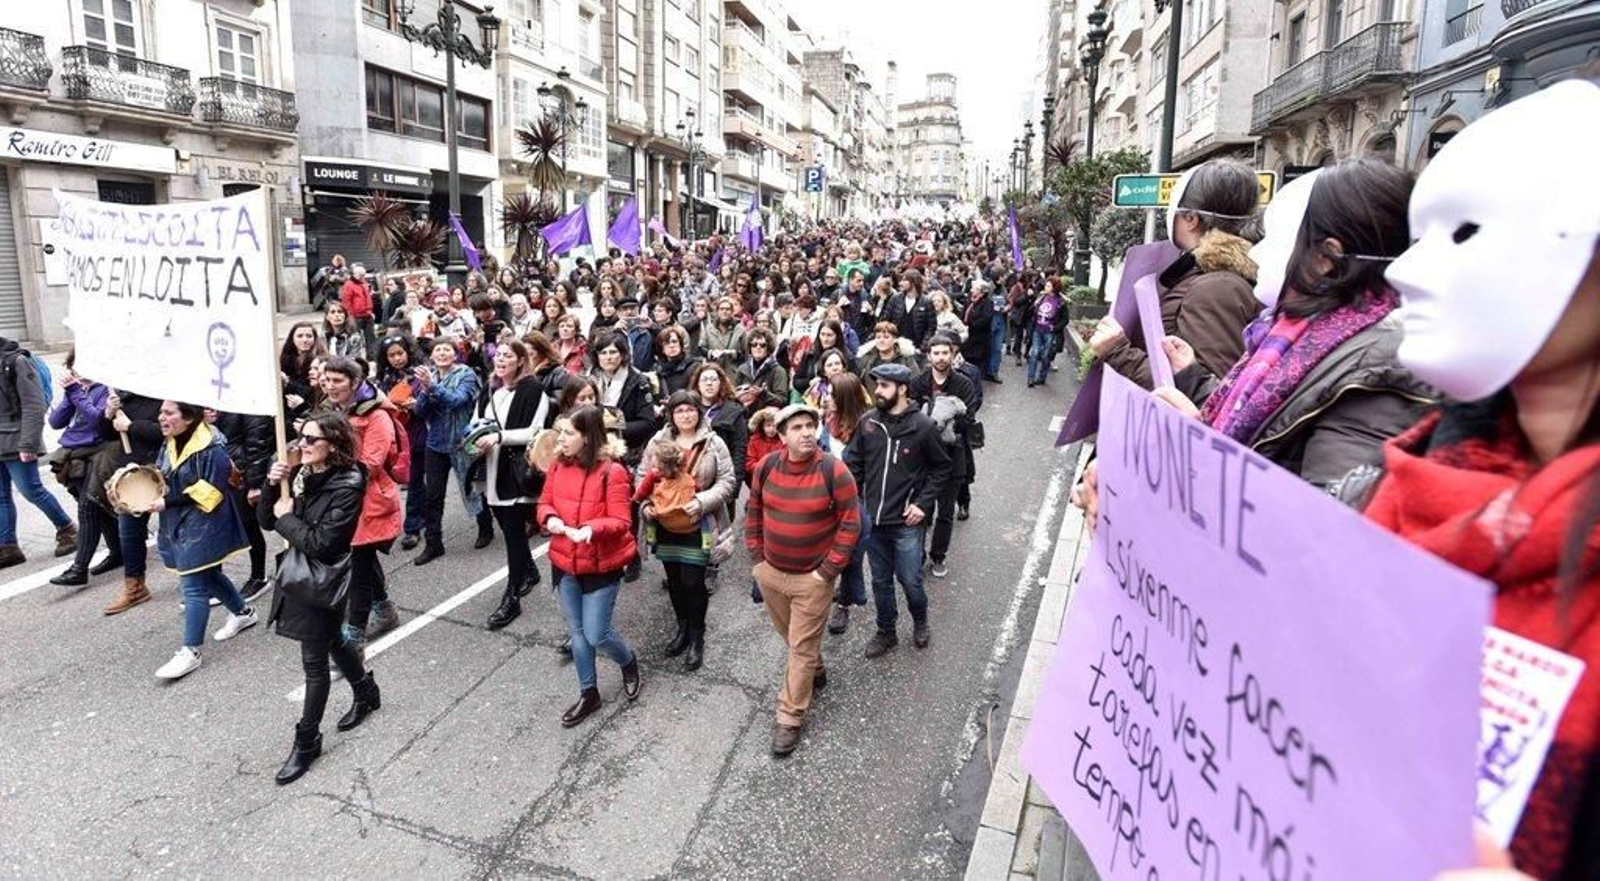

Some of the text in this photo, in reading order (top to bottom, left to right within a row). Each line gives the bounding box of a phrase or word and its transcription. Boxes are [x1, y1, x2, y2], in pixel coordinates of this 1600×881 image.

[217, 166, 234, 179] EL
[314, 168, 358, 180] LOUNGE
[383, 174, 394, 184] LE
[808, 170, 819, 183] P
[1111, 613, 1160, 718] cada
[1170, 692, 1220, 794] vez
[1225, 642, 1338, 803] facer
[1073, 725, 1146, 873] tempo
